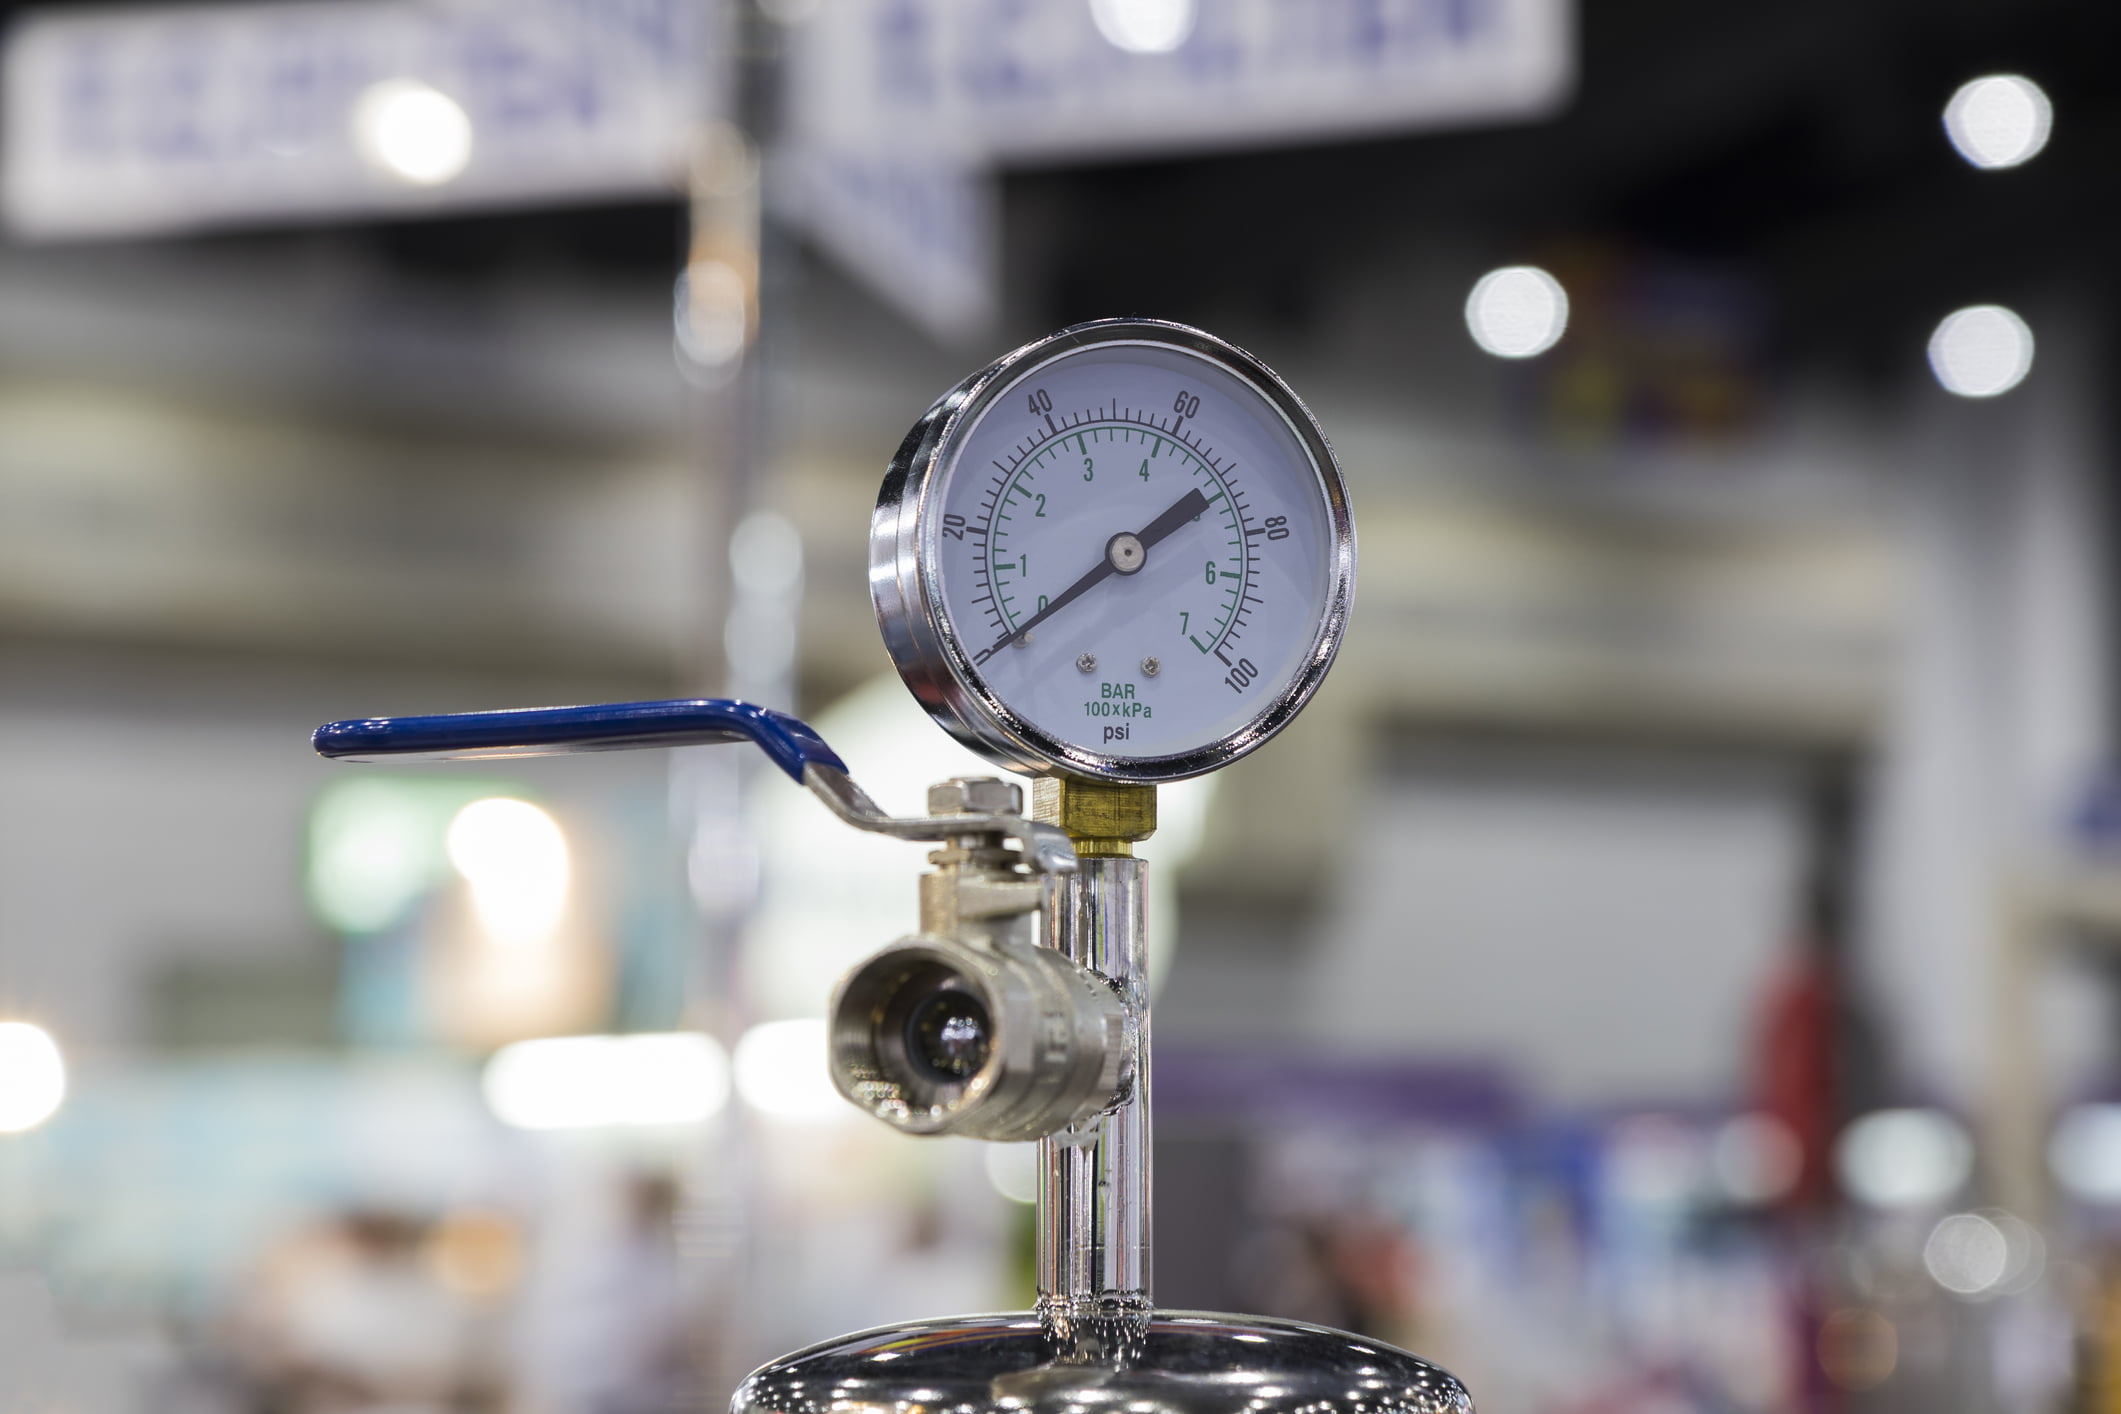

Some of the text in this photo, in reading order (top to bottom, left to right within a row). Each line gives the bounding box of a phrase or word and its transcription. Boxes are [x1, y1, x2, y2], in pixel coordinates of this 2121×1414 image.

[1028, 389, 1053, 415] 40
[1173, 390, 1200, 418] 60
[1083, 458, 1094, 482] 3
[1138, 459, 1150, 482] 4
[1035, 494, 1046, 517] 2
[943, 514, 967, 540] 20
[1264, 516, 1290, 541] 80
[1019, 554, 1028, 577] 1
[1205, 561, 1216, 584] 6
[1179, 612, 1190, 635] 7
[1224, 658, 1259, 693] 100
[1101, 683, 1135, 699] BAR
[1084, 701, 1152, 719] 100xkPa
[1103, 723, 1130, 744] psi
